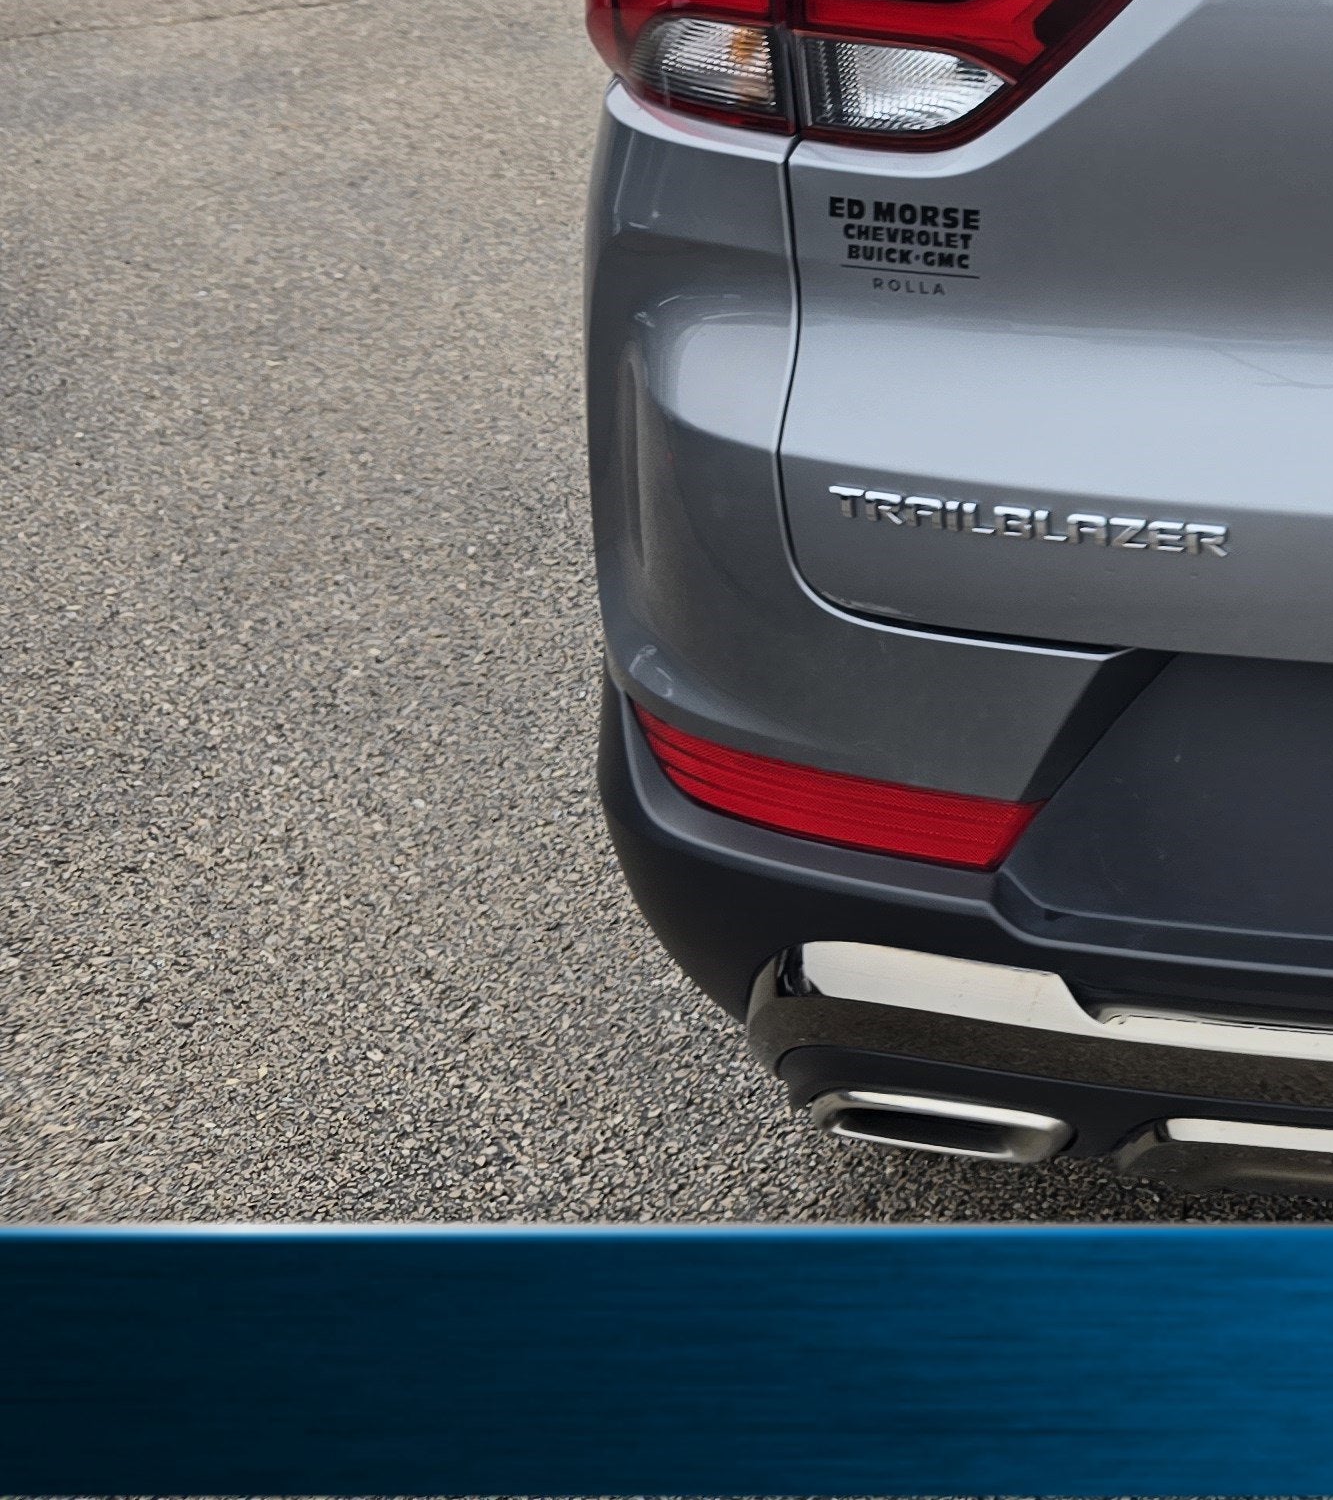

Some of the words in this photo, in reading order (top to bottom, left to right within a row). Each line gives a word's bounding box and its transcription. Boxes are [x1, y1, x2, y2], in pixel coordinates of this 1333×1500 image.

[828, 196, 865, 220] ED
[873, 200, 981, 231] MORSE
[843, 223, 973, 250] CHEVROLET
[873, 277, 946, 296] ROLLA
[828, 485, 1230, 558] TRAILBLAZER
